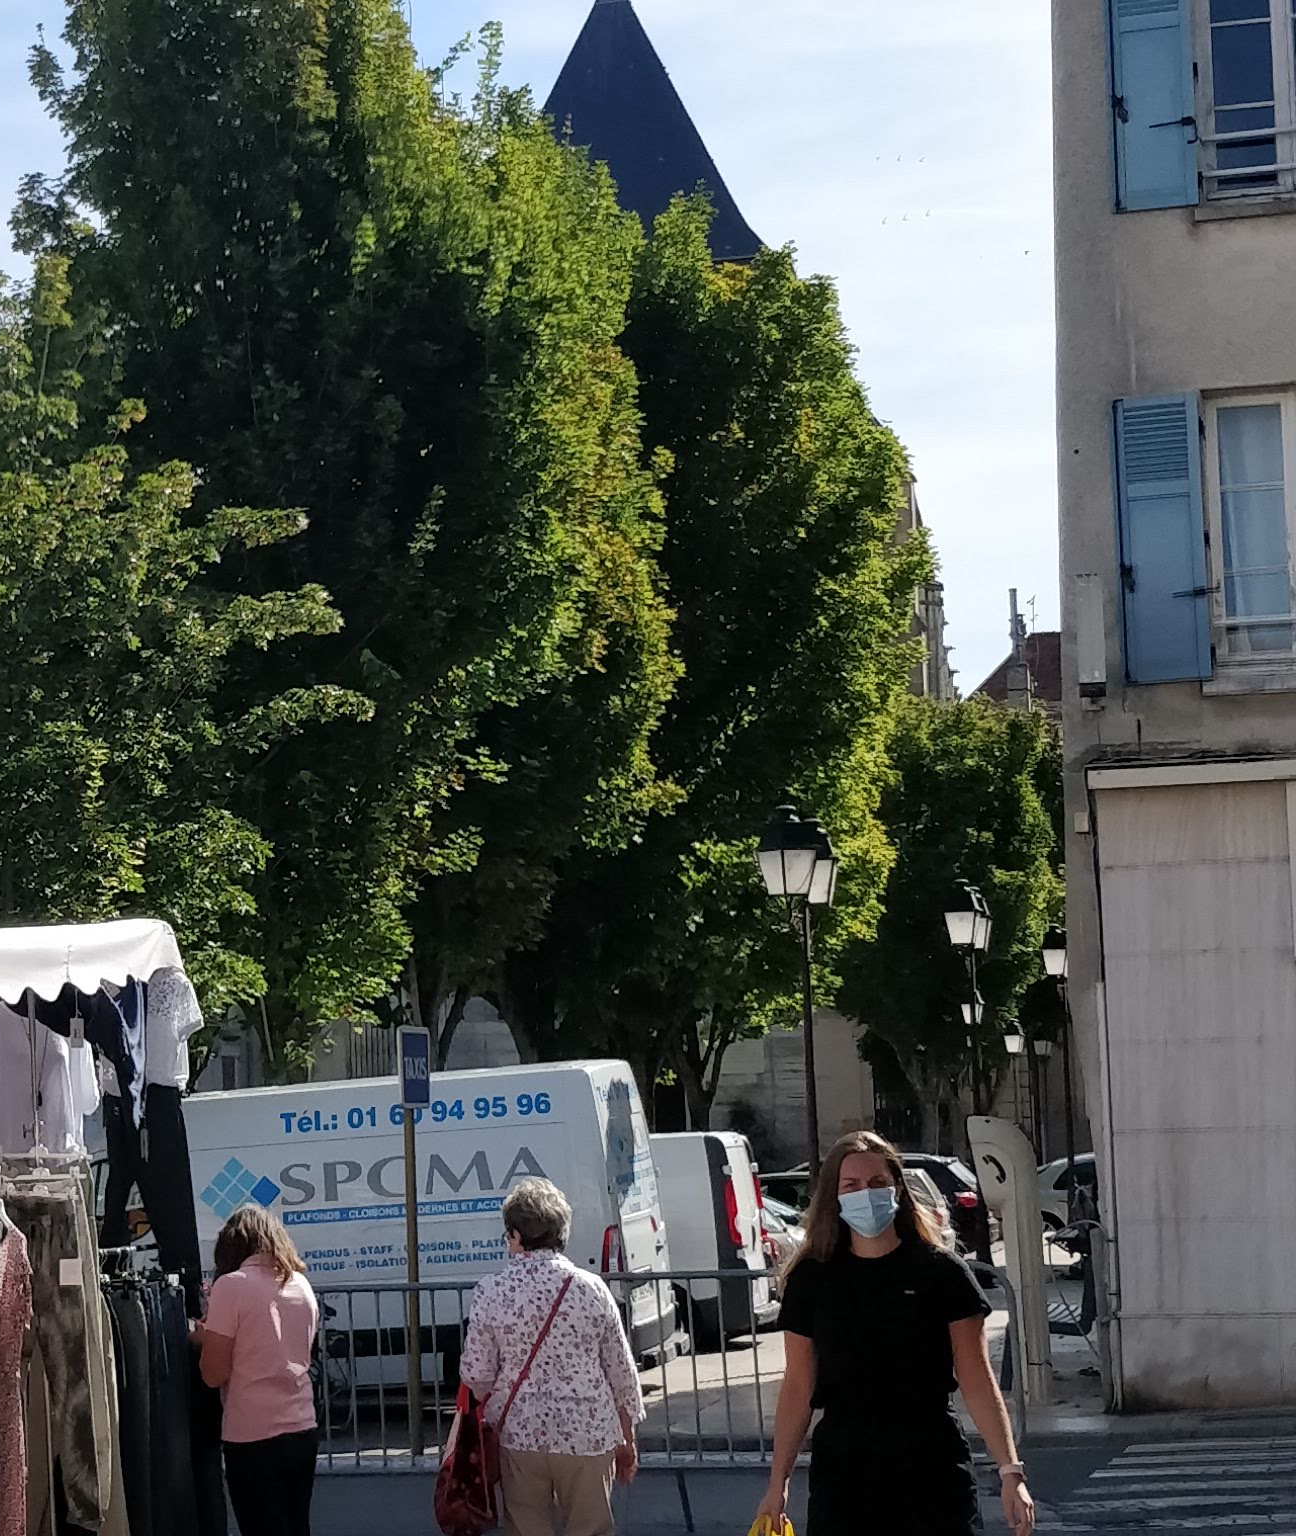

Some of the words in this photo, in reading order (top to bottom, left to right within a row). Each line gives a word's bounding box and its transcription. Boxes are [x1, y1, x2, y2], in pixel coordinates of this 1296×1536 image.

[403, 1057, 427, 1080] TAXIS
[280, 1109, 338, 1134] Tél.:
[347, 1106, 377, 1129] 01
[432, 1100, 464, 1123] 94
[474, 1096, 507, 1119] 95
[517, 1092, 551, 1115] 96
[287, 1210, 341, 1223] PLAFONDS
[348, 1207, 400, 1219] CLOISONS
[402, 1202, 459, 1215] DERNES
[477, 1199, 504, 1210] ACOU
[301, 1248, 350, 1260] PENDUS
[360, 1244, 393, 1255] STAFF
[405, 1241, 461, 1253] OISONS
[356, 1257, 407, 1269] ISOLATIO
